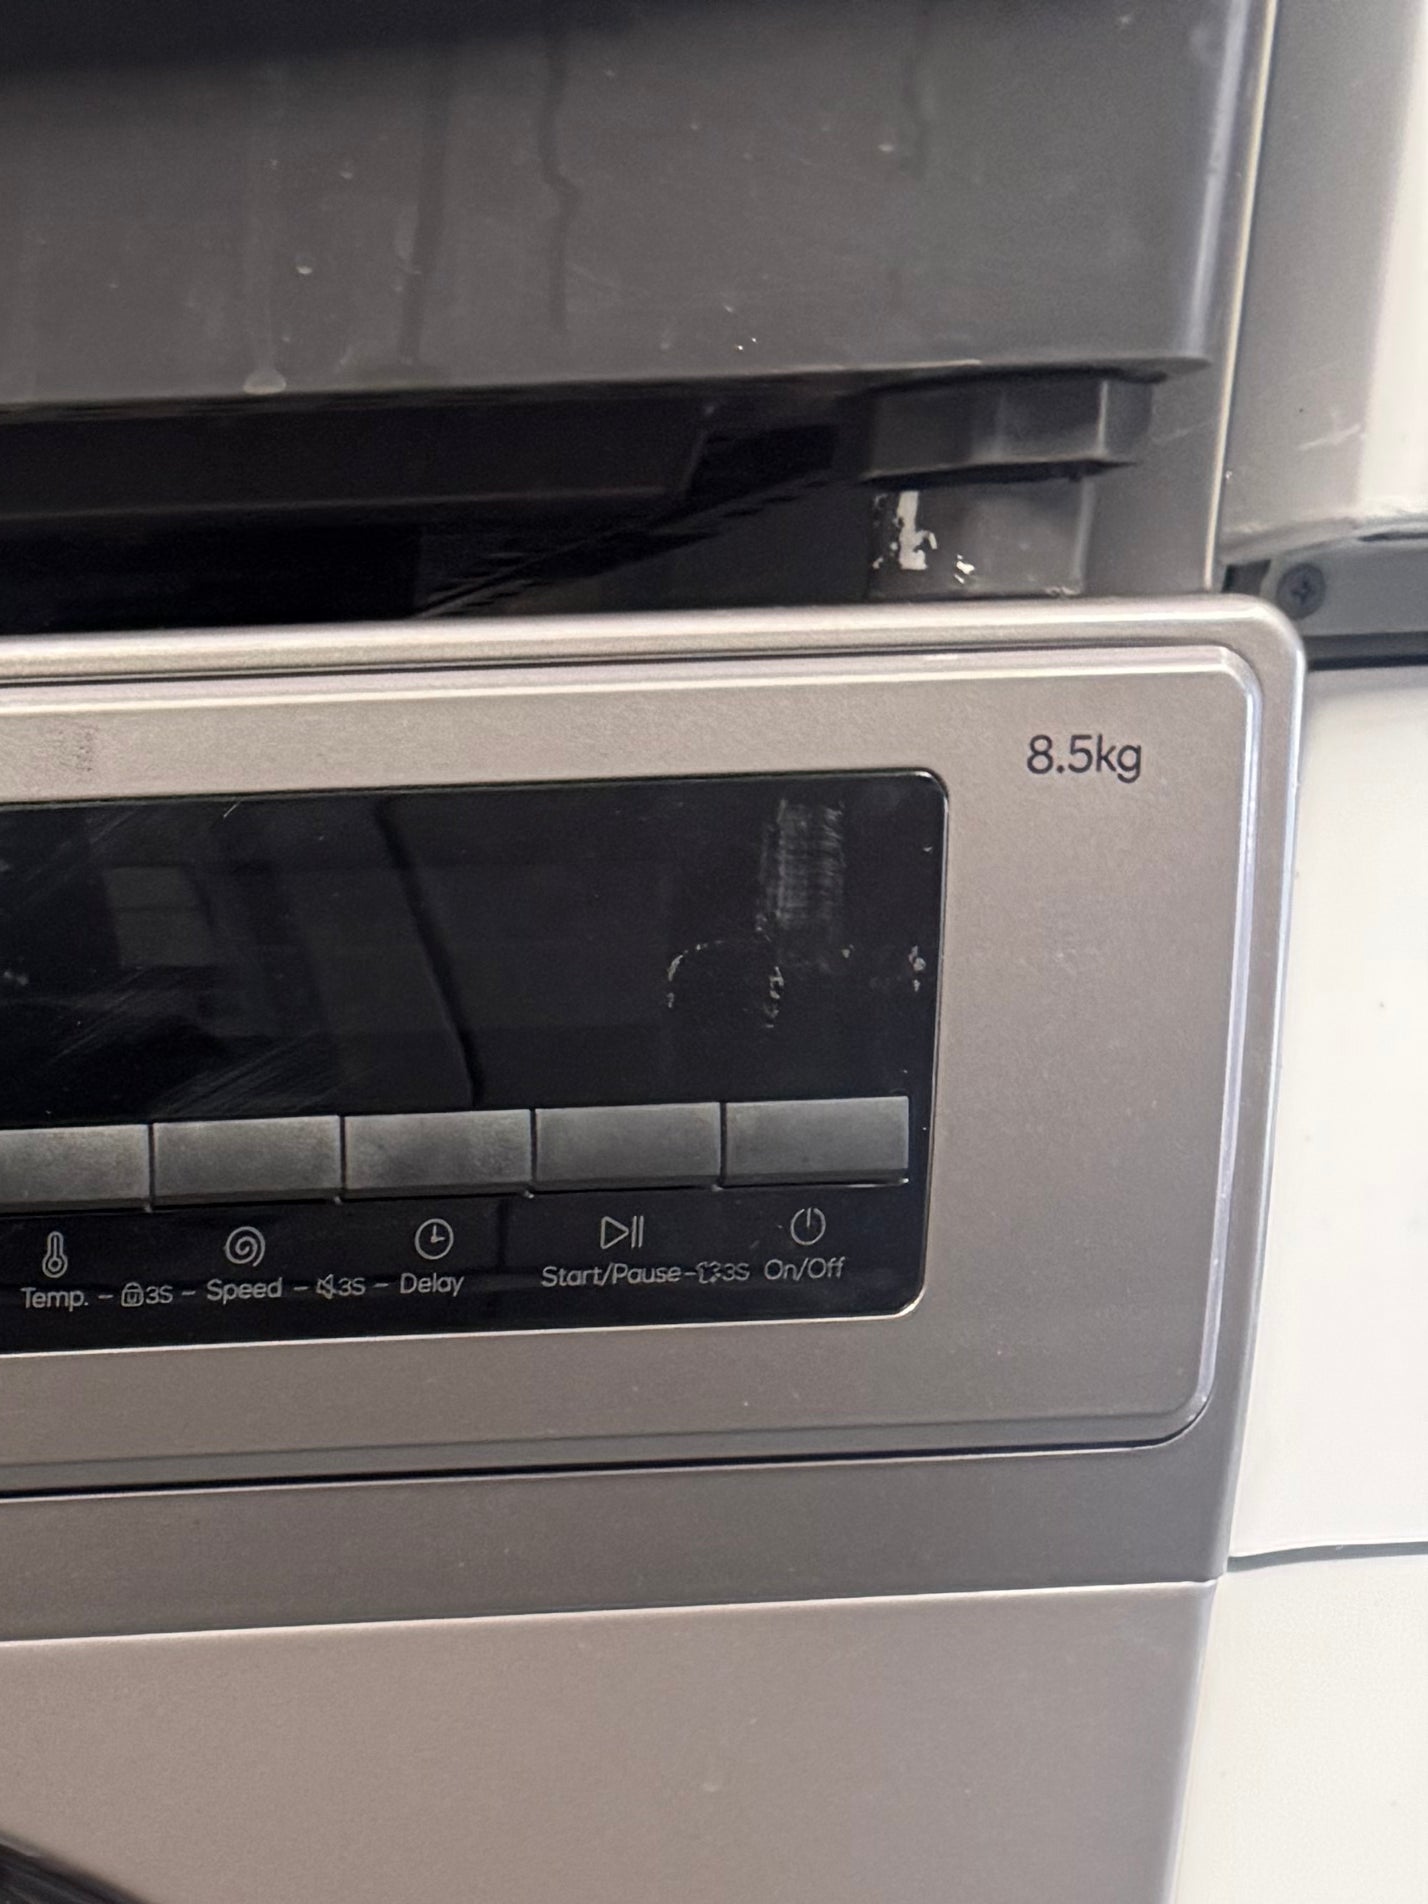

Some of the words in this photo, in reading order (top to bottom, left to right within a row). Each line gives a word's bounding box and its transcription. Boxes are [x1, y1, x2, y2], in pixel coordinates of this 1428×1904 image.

[1026, 734, 1142, 783] 8.5kg
[764, 1256, 845, 1281] On/Off
[21, 1286, 88, 1313] Temp.
[207, 1276, 283, 1305] Speed
[399, 1272, 465, 1298] Delay
